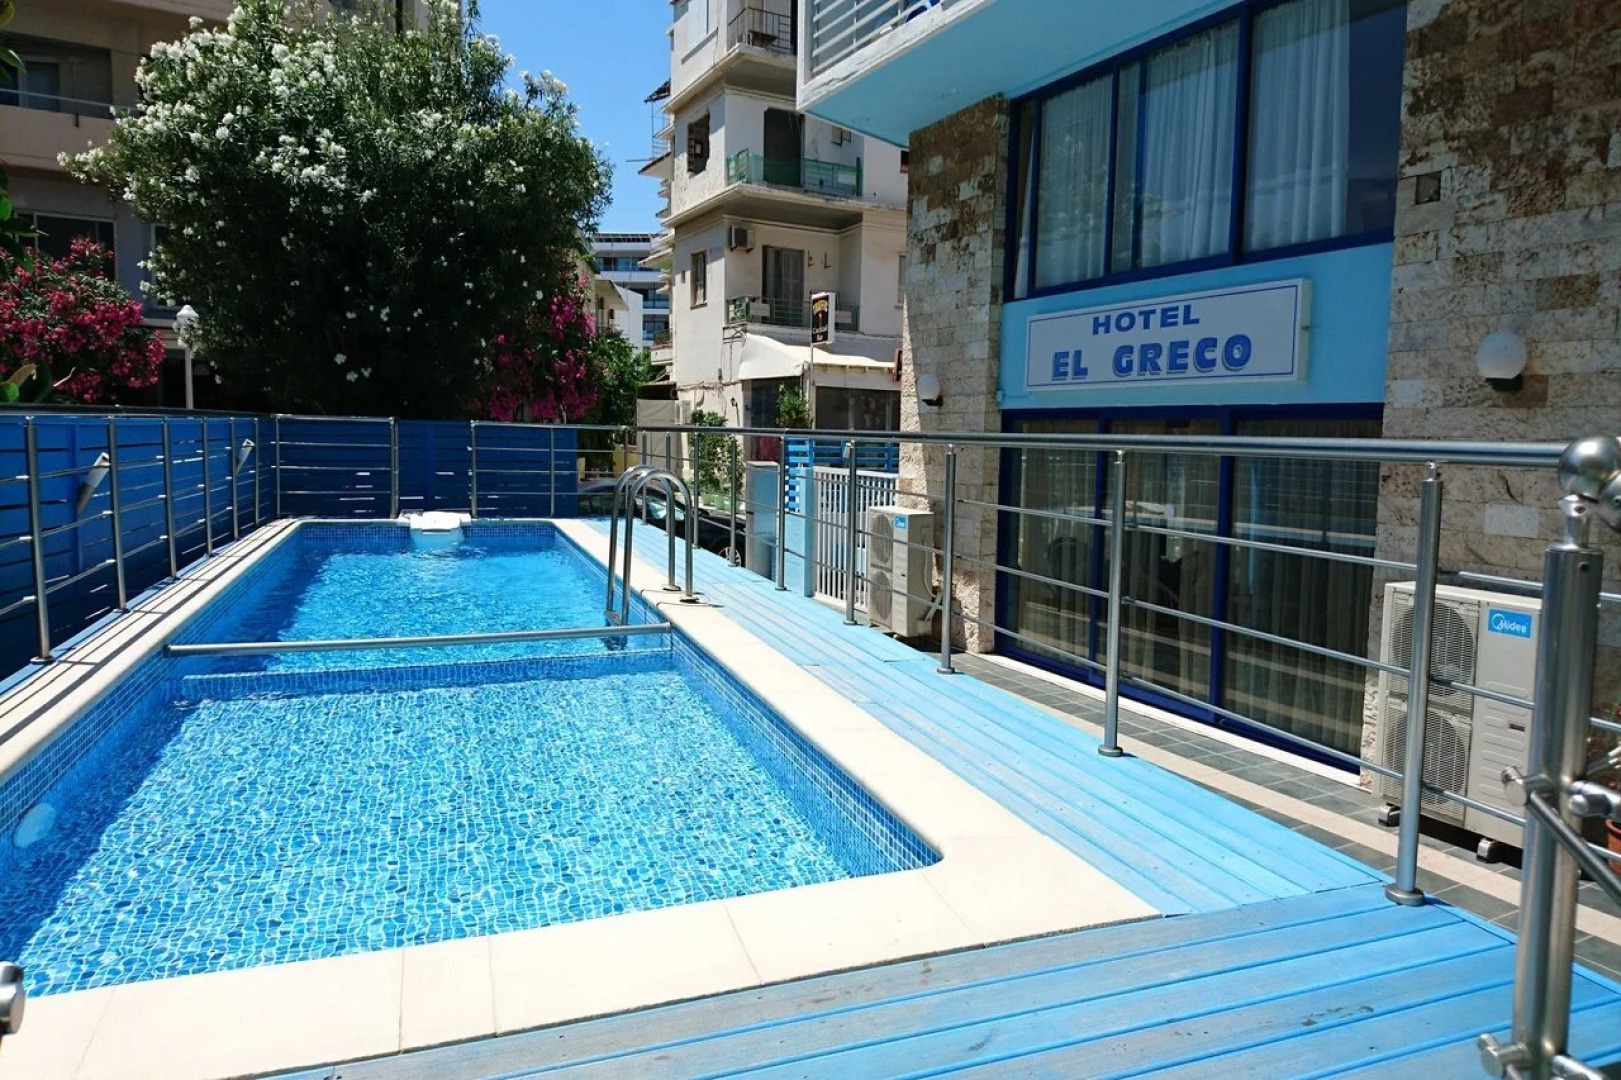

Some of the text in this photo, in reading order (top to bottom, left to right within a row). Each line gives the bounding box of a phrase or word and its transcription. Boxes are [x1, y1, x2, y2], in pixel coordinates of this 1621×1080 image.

[1092, 304, 1200, 335] HOTEL
[1052, 334, 1252, 380] EL GRECO
[1492, 614, 1527, 633] Midea
